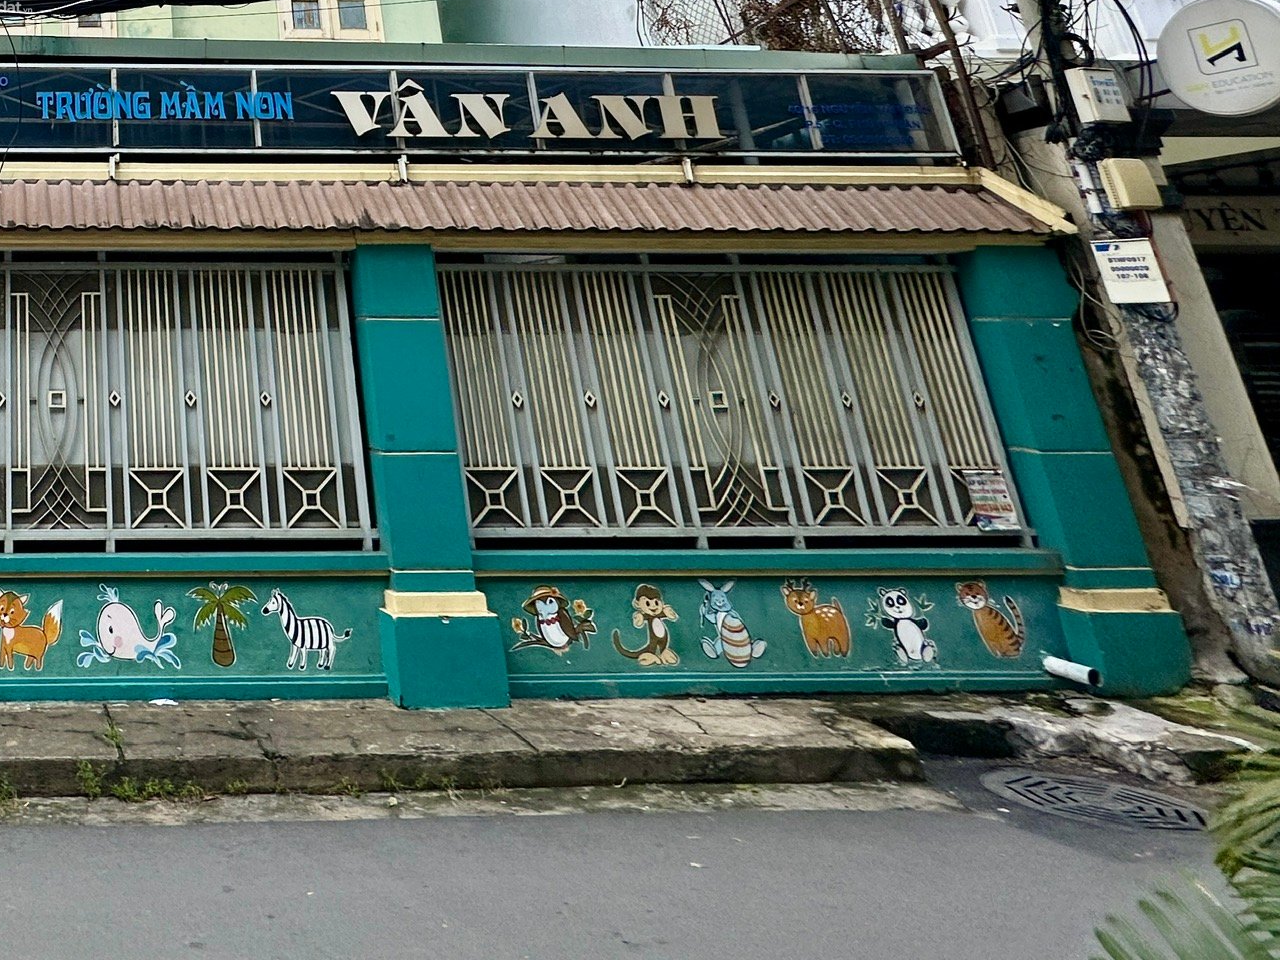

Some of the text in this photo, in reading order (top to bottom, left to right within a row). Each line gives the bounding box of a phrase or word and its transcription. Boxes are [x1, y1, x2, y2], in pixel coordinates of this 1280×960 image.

[35, 80, 295, 123] TRƯỜNG MẦM NON
[329, 78, 728, 141] VÂN ANH
